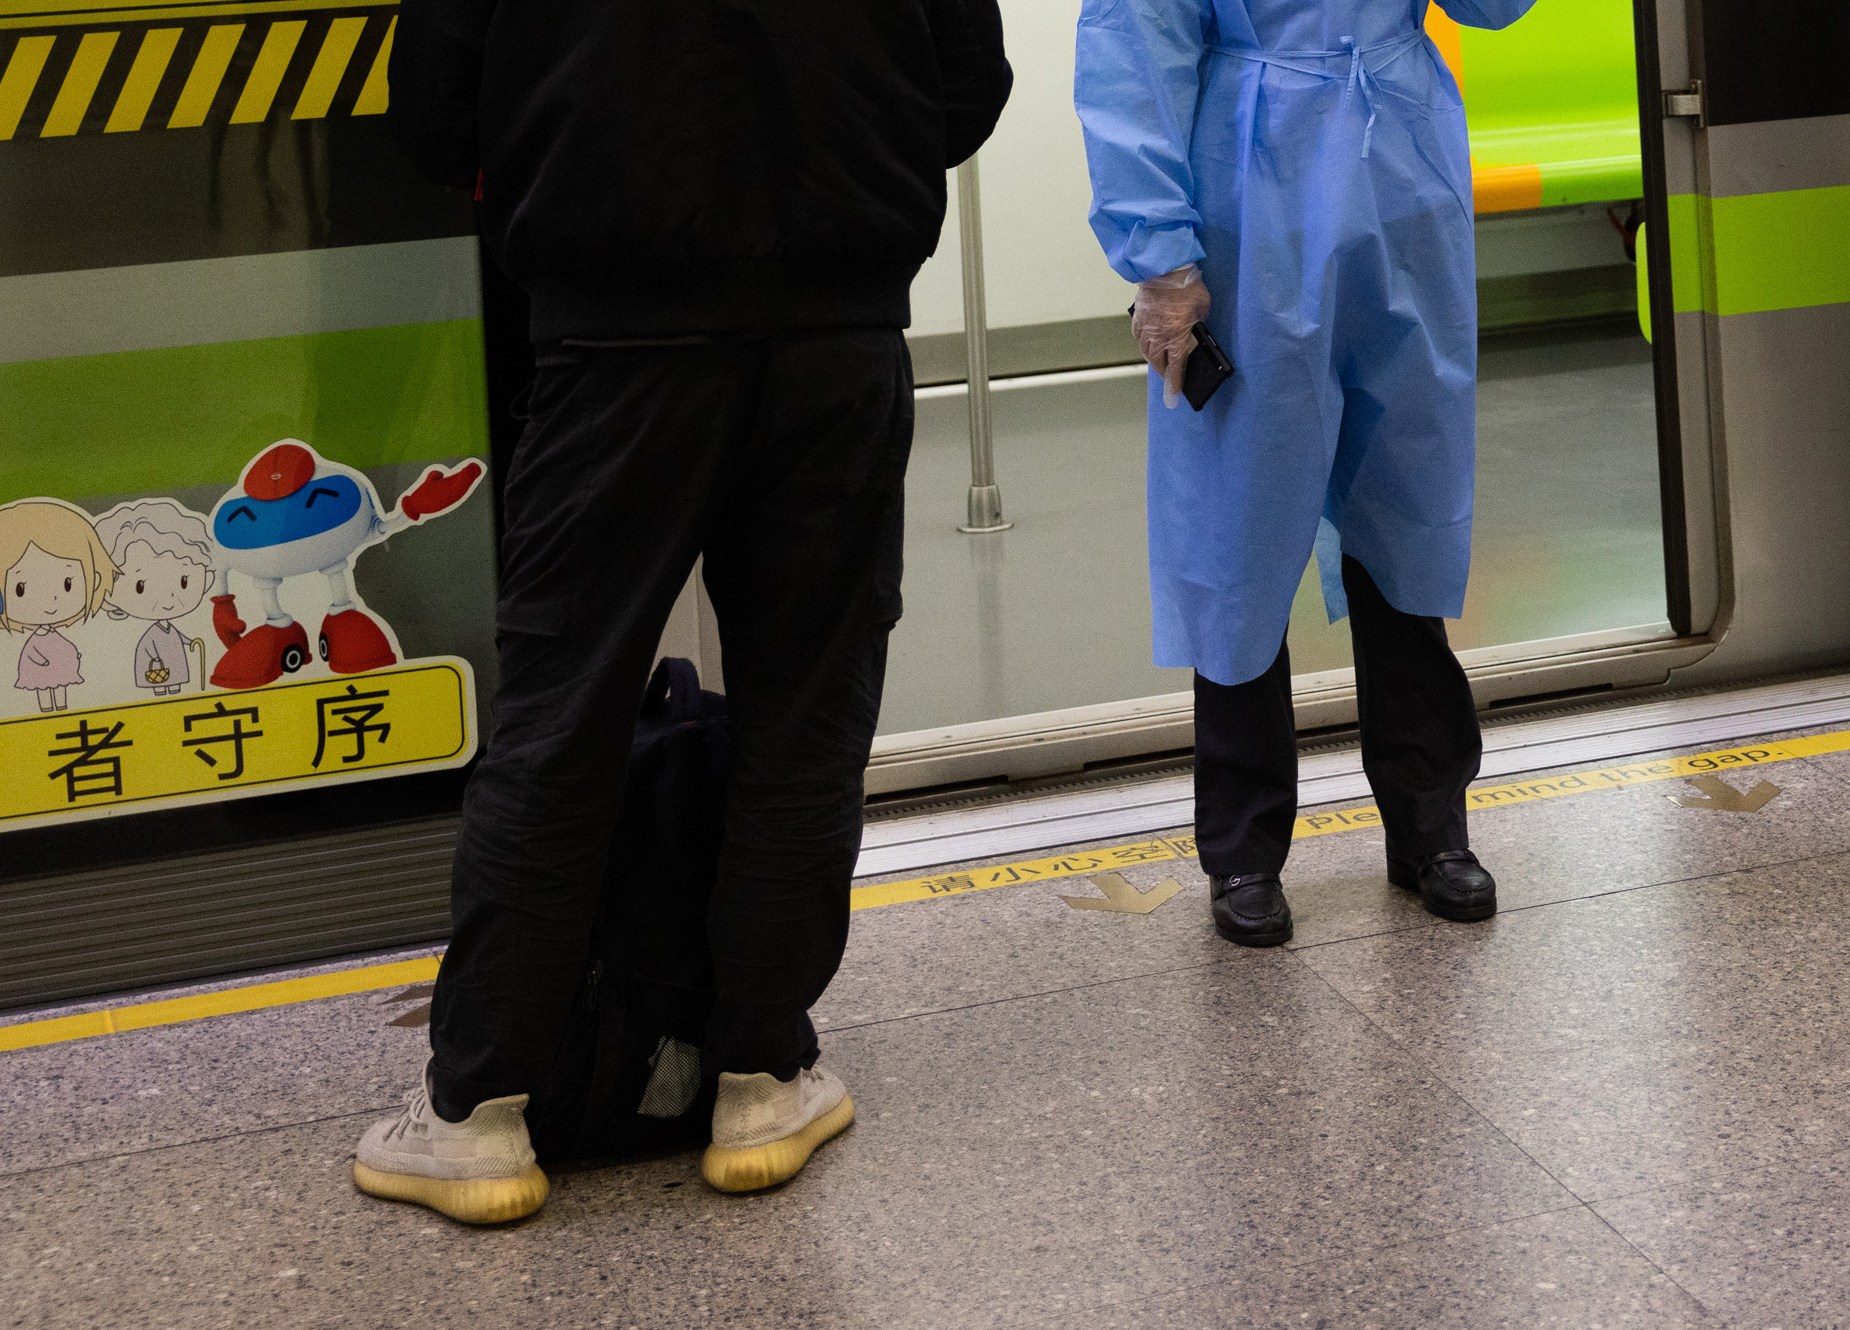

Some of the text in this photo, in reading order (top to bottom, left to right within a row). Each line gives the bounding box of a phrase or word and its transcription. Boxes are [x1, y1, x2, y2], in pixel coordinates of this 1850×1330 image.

[48, 685, 392, 803] 者守序
[1471, 775, 1587, 805] mind
[1600, 760, 1675, 785] the
[1688, 747, 1784, 772] gap.
